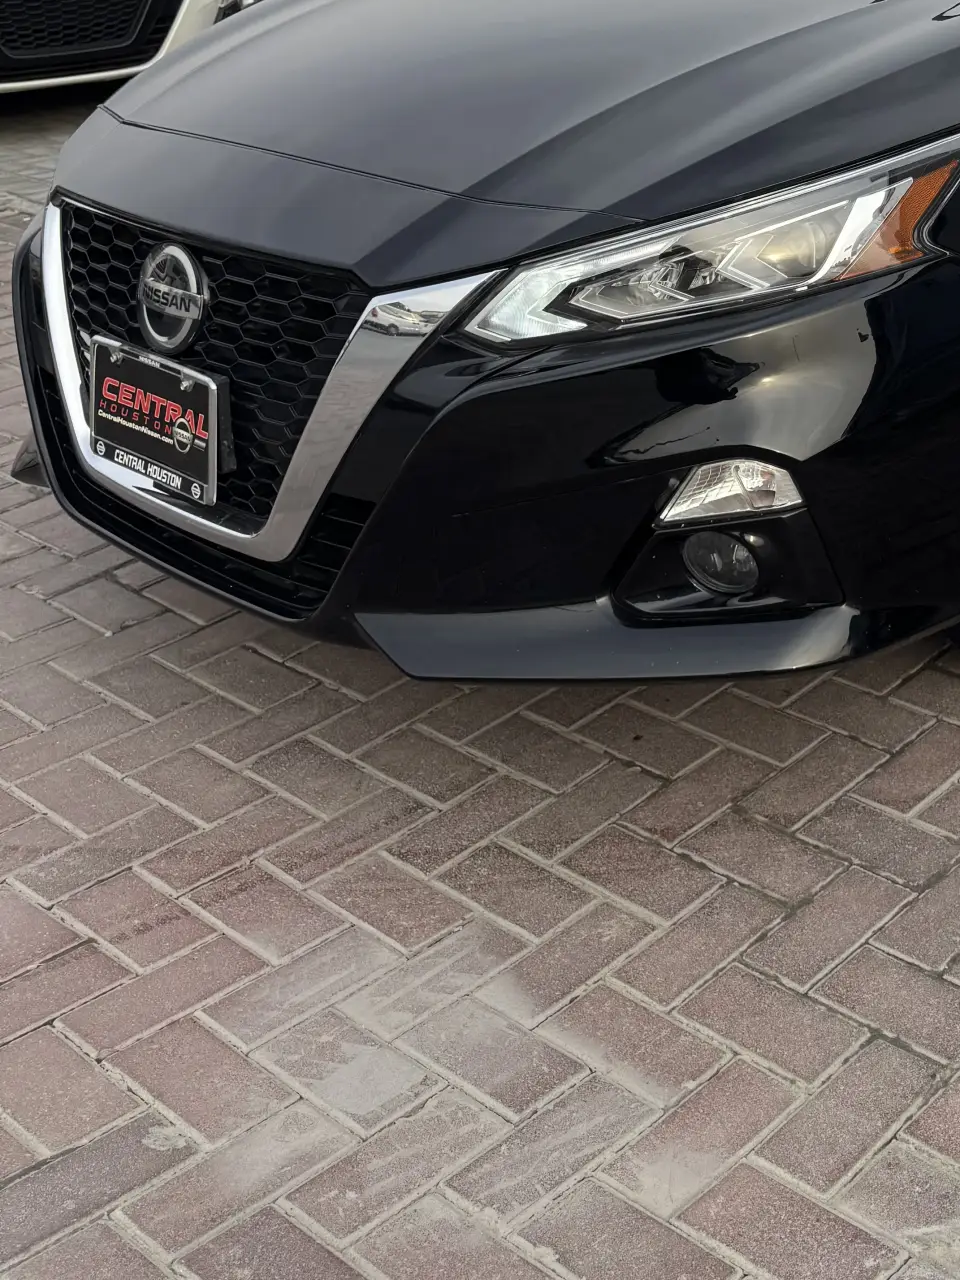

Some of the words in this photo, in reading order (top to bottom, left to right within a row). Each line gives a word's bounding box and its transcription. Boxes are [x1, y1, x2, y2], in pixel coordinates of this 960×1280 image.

[142, 282, 192, 313] NISSAN
[138, 355, 161, 369] NISSAN
[99, 399, 173, 435] HOUSTON
[101, 376, 209, 440] CENTRAL
[97, 408, 174, 445] CentralHoustonNissan.com
[114, 449, 146, 477] CENTRAL
[147, 462, 182, 490] HOUSTON
